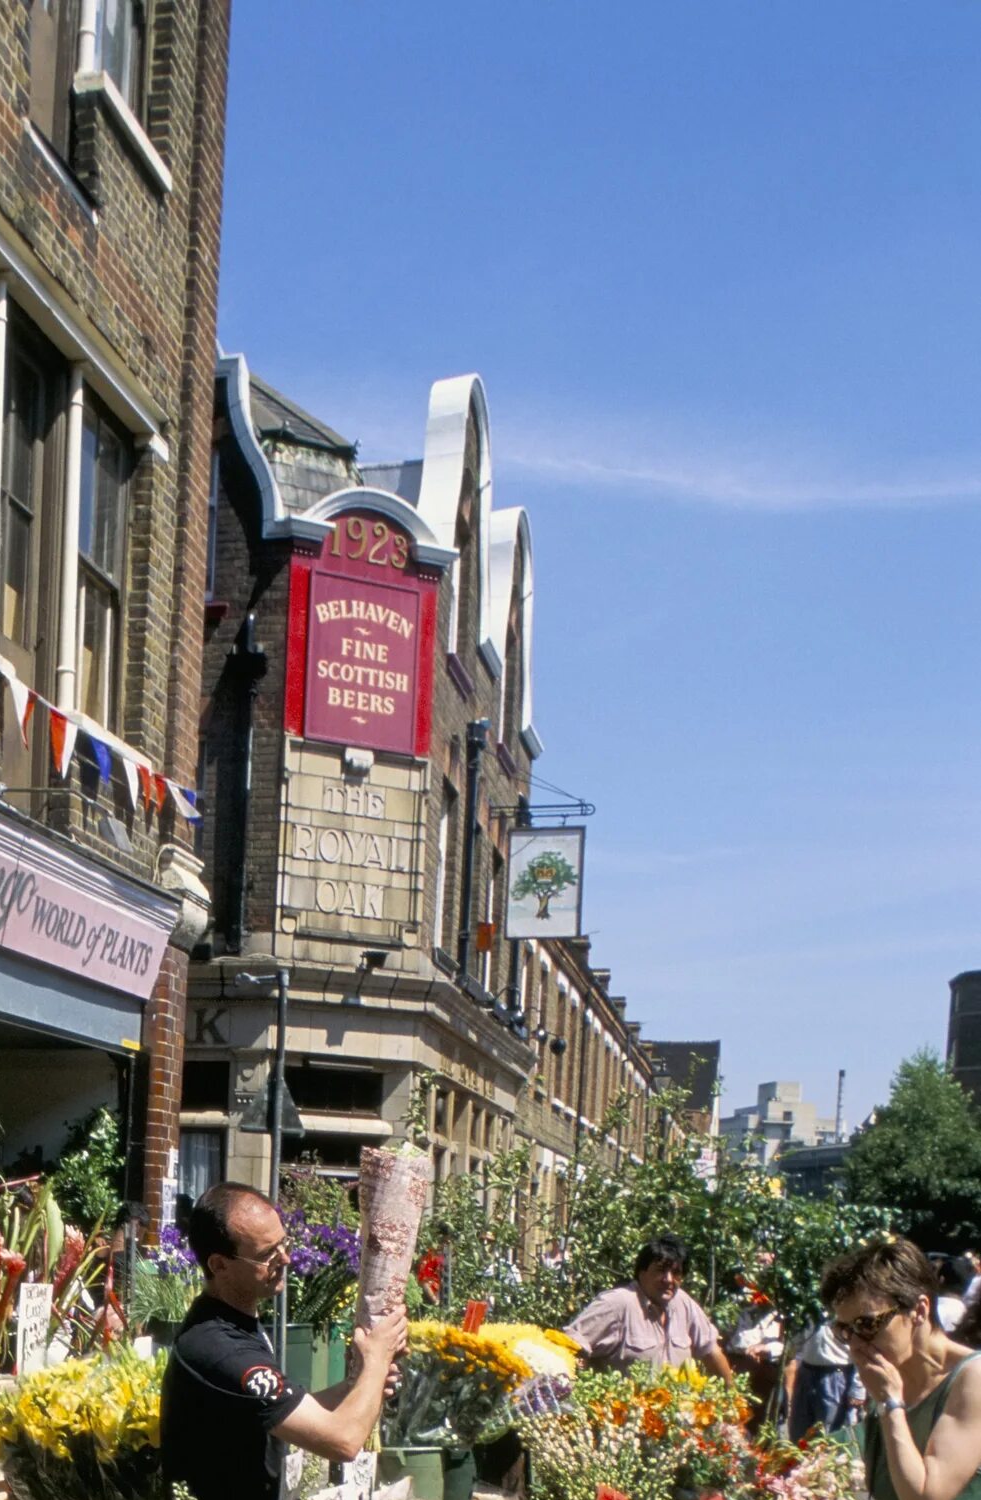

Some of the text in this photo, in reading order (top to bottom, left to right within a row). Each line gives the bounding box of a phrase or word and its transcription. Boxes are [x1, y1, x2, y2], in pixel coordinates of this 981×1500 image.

[329, 516, 408, 569] 1923
[316, 600, 414, 639] BELHAVEN
[341, 637, 389, 663] FINE
[317, 660, 408, 693] SCOTTISH
[328, 686, 394, 715] BEERS
[323, 786, 384, 819] THE
[292, 823, 411, 873] ROYAL
[316, 880, 383, 919] OAK
[31, 895, 85, 949] WORLD
[83, 925, 102, 967] of
[102, 929, 153, 977] PLANTS
